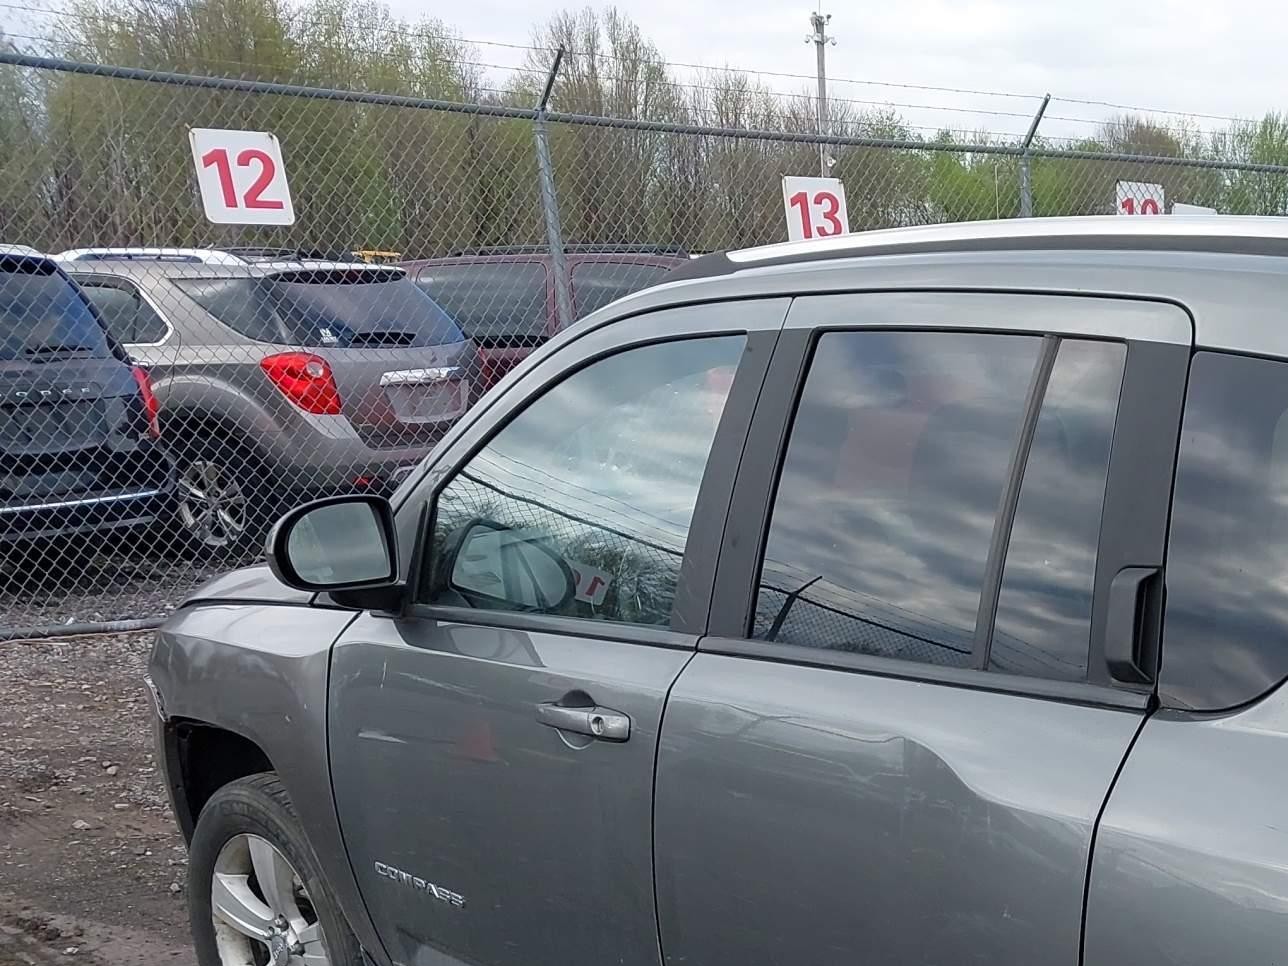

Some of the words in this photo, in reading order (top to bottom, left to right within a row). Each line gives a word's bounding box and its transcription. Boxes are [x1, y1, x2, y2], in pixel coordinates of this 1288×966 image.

[202, 149, 284, 209] 12
[790, 192, 842, 239] 13
[375, 861, 464, 906] COMPASS
